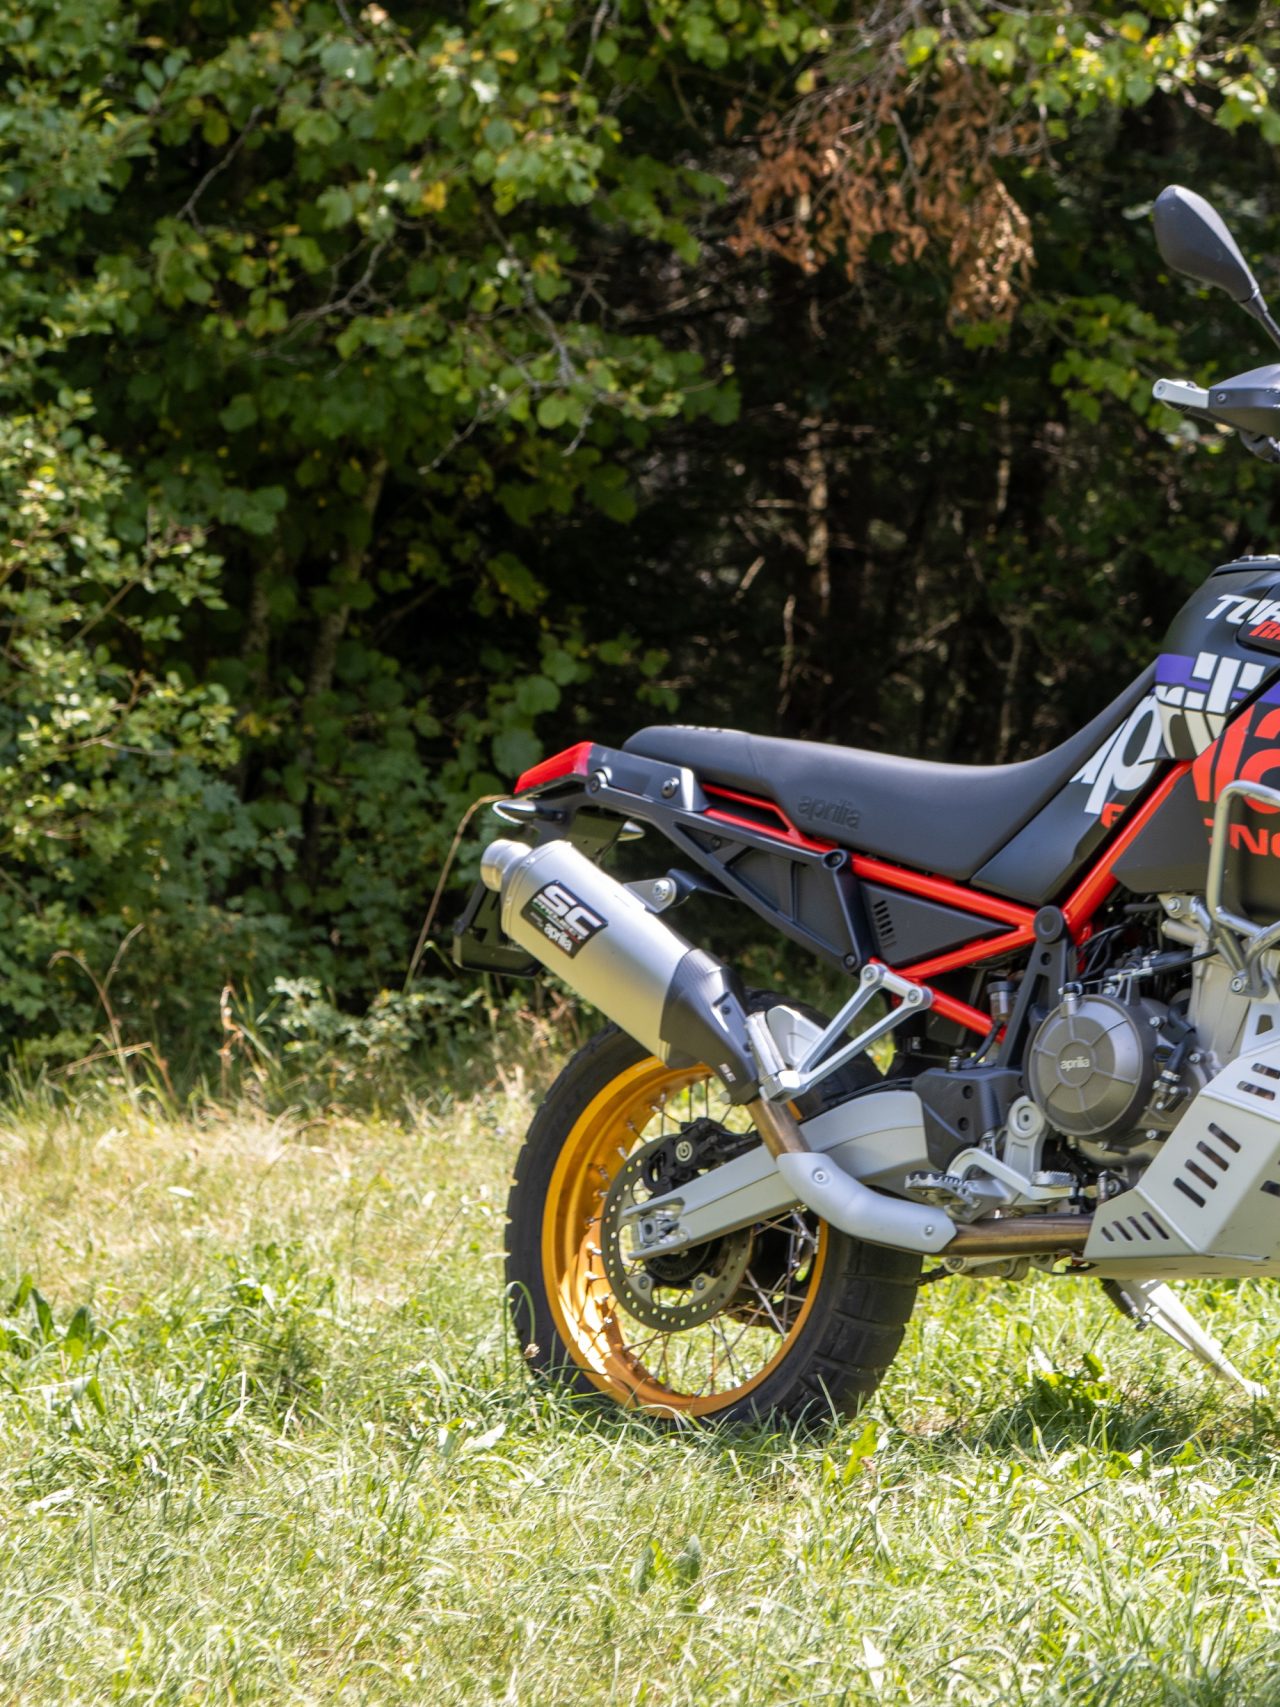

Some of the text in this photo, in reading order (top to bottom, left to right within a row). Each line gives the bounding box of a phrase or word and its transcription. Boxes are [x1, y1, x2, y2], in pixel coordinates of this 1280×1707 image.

[798, 795, 862, 830] aprilia
[537, 885, 603, 938] SC
[1060, 1056, 1090, 1072] aprilia
